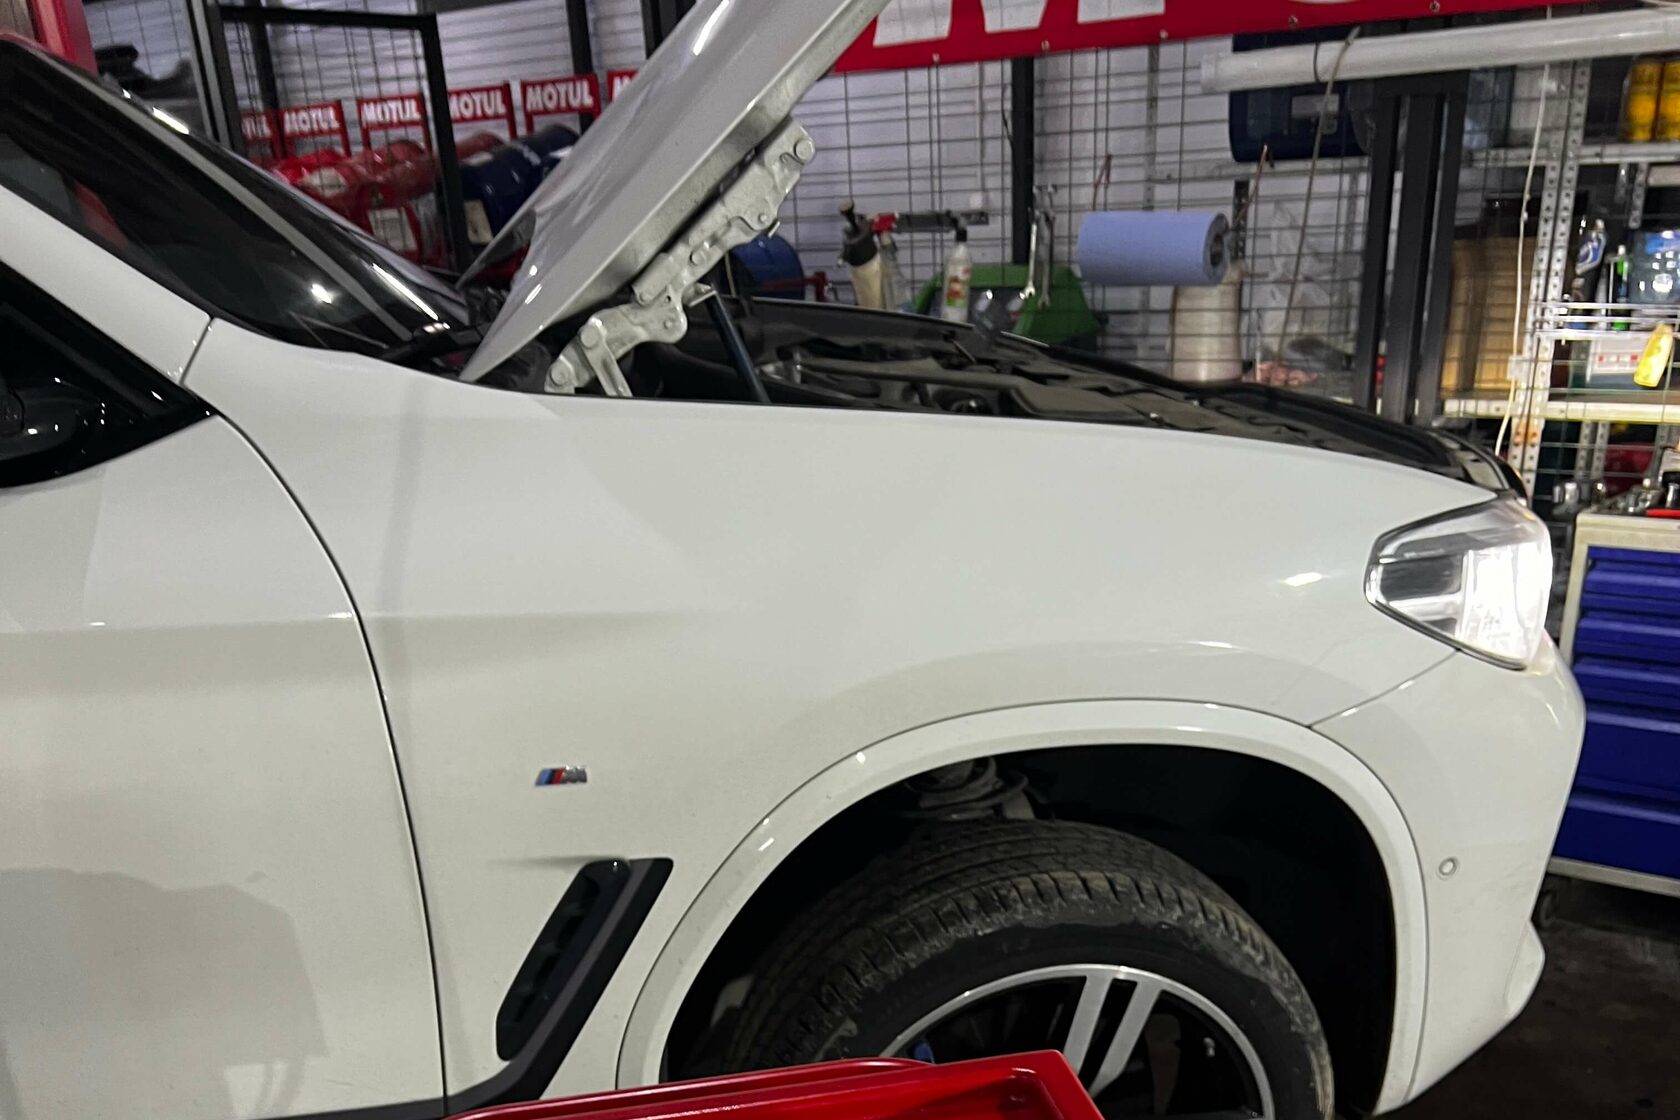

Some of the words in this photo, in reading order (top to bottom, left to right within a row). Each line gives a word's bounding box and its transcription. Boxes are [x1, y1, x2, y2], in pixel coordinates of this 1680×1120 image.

[450, 90, 506, 119] MOTUL
[526, 79, 593, 112] MOTUL
[284, 106, 340, 135] MOTUL
[363, 98, 421, 127] MOTUL
